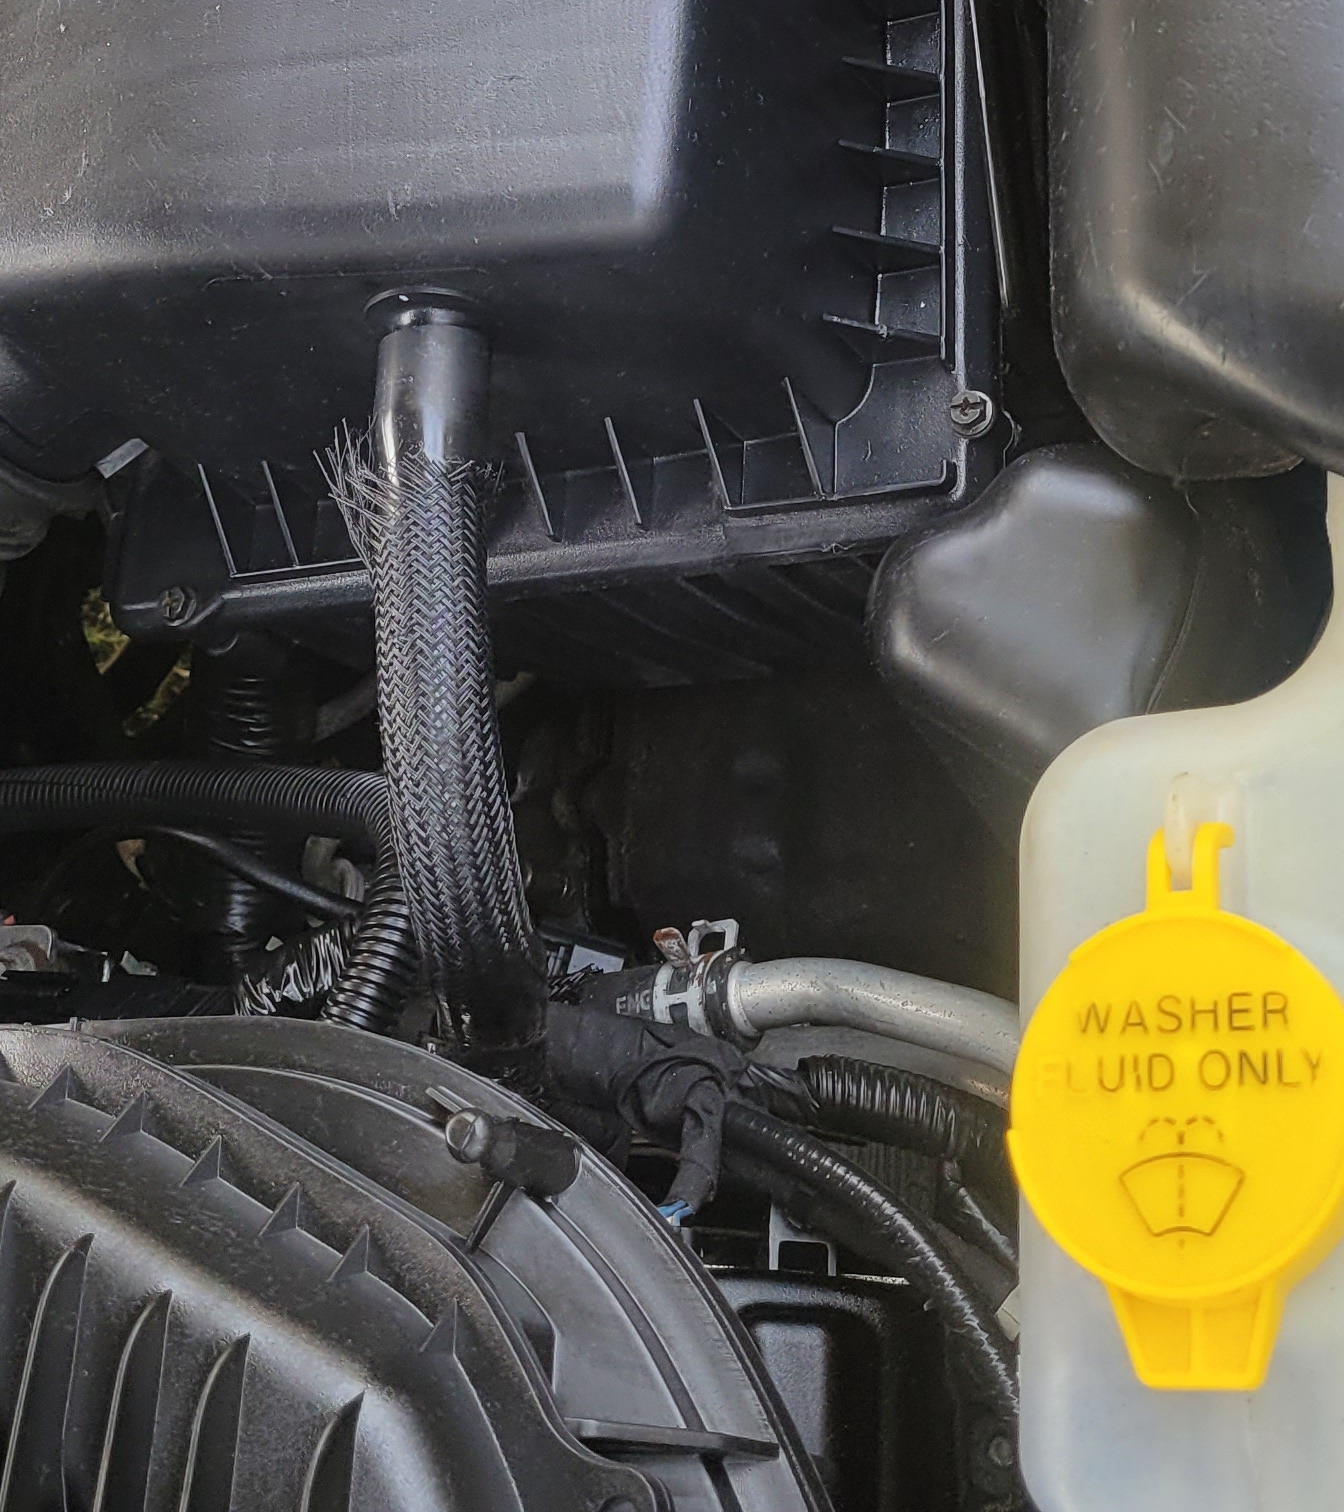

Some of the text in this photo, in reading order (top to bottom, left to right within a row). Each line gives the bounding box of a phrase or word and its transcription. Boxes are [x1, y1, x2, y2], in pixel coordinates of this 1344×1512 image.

[1076, 991, 1290, 1036] WASHER
[1035, 1048, 1323, 1093] FLUID ONLY
